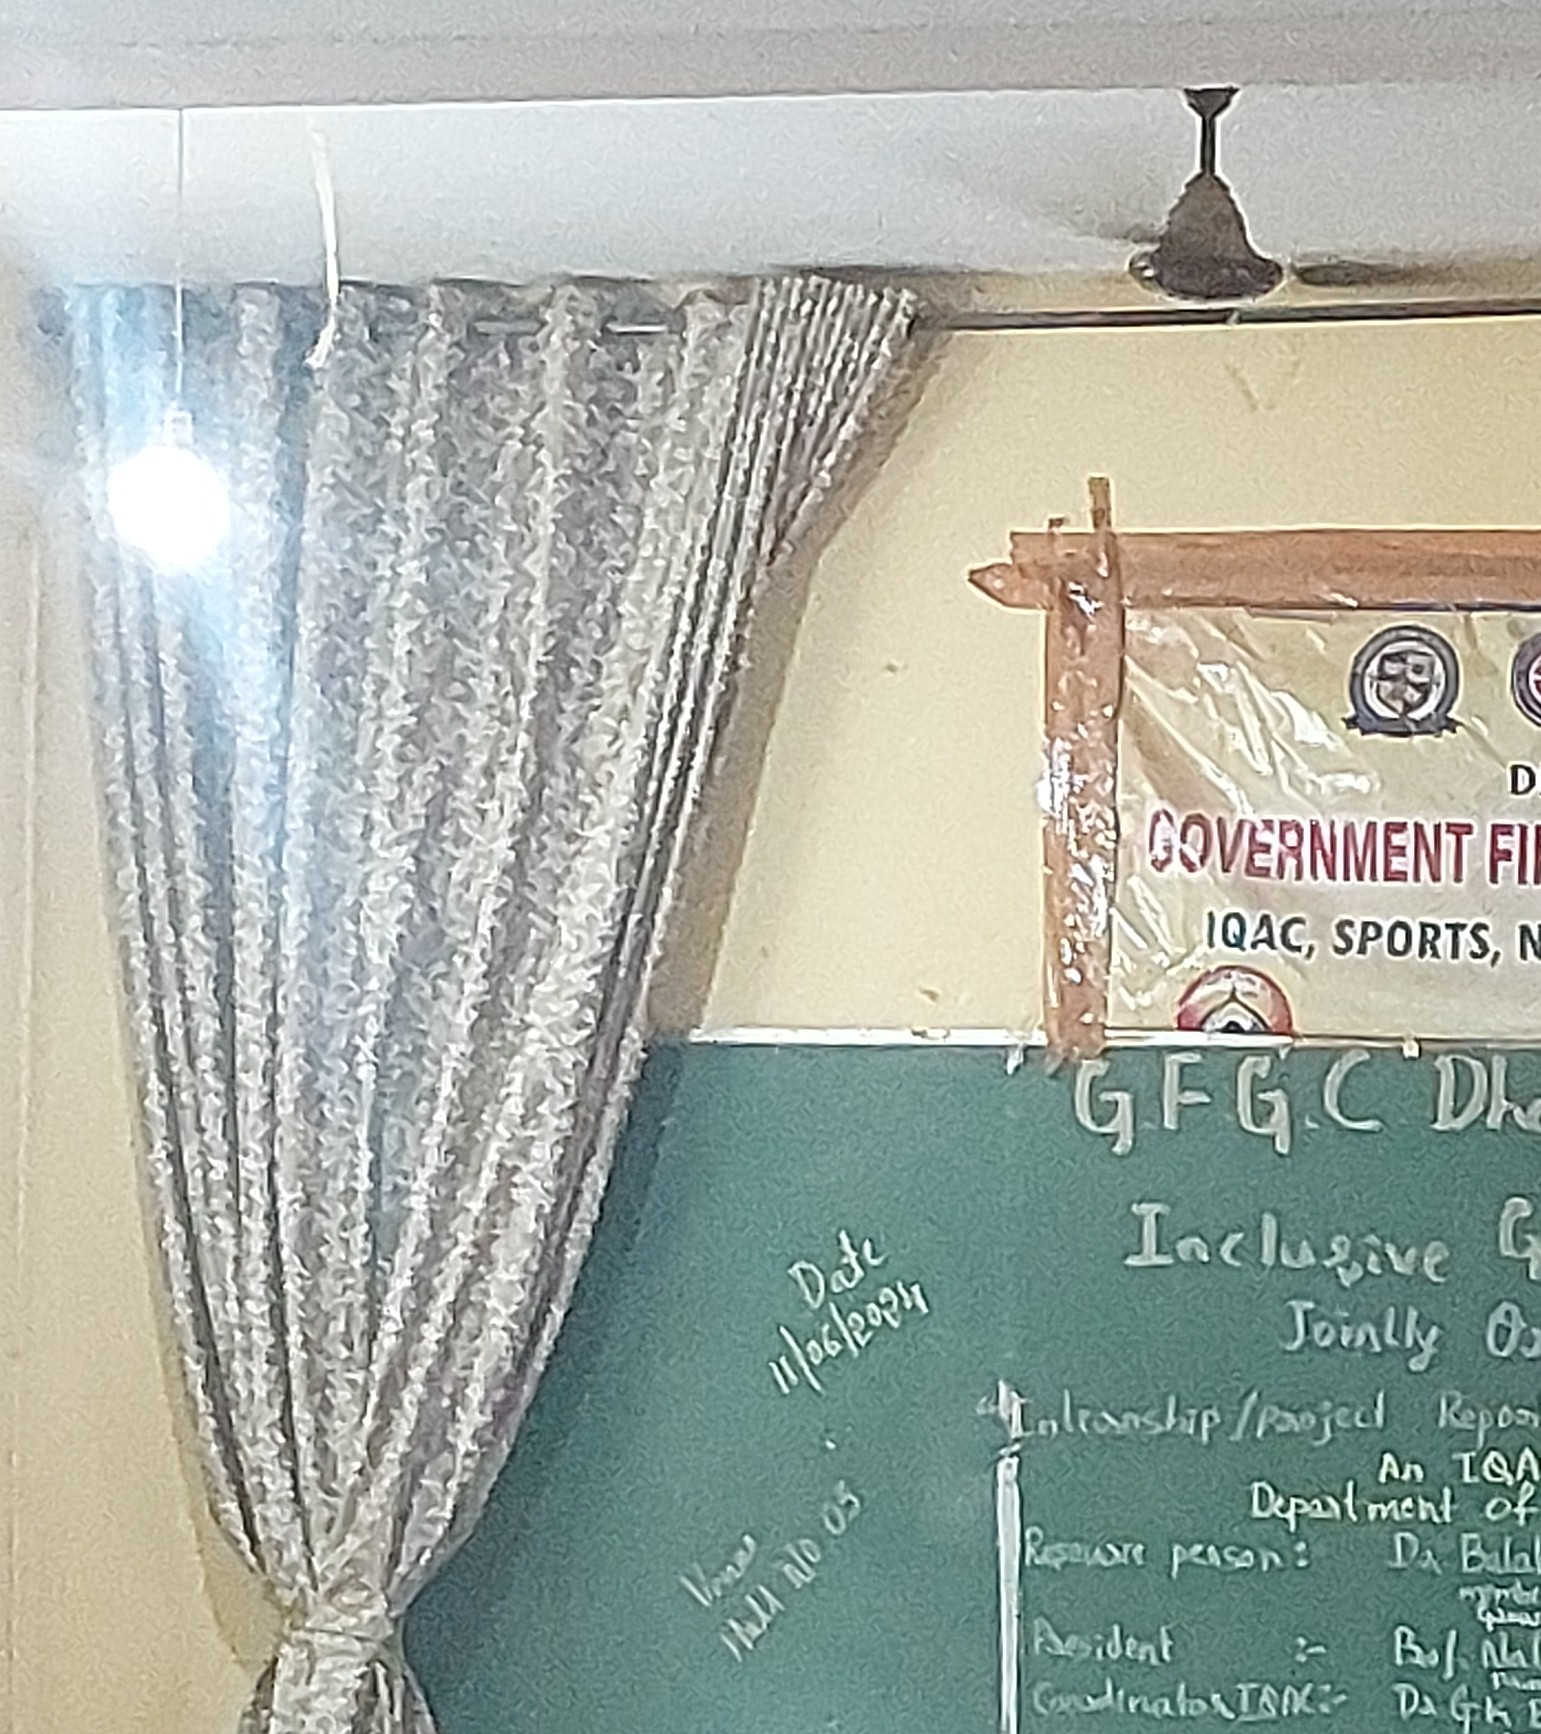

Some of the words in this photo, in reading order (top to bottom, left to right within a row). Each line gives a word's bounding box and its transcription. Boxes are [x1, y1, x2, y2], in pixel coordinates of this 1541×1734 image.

[1148, 808, 1473, 886] GOVERNMENT
[1205, 910, 1315, 960] IQAC,
[1332, 916, 1503, 967] SPORTS,
[787, 1229, 889, 1311] Date
[1123, 1202, 1450, 1288] Inclusive
[1284, 1299, 1440, 1372] Jointly
[1378, 1451, 1426, 1484] An
[1249, 1481, 1456, 1532] Department
[1484, 1483, 1541, 1526] of
